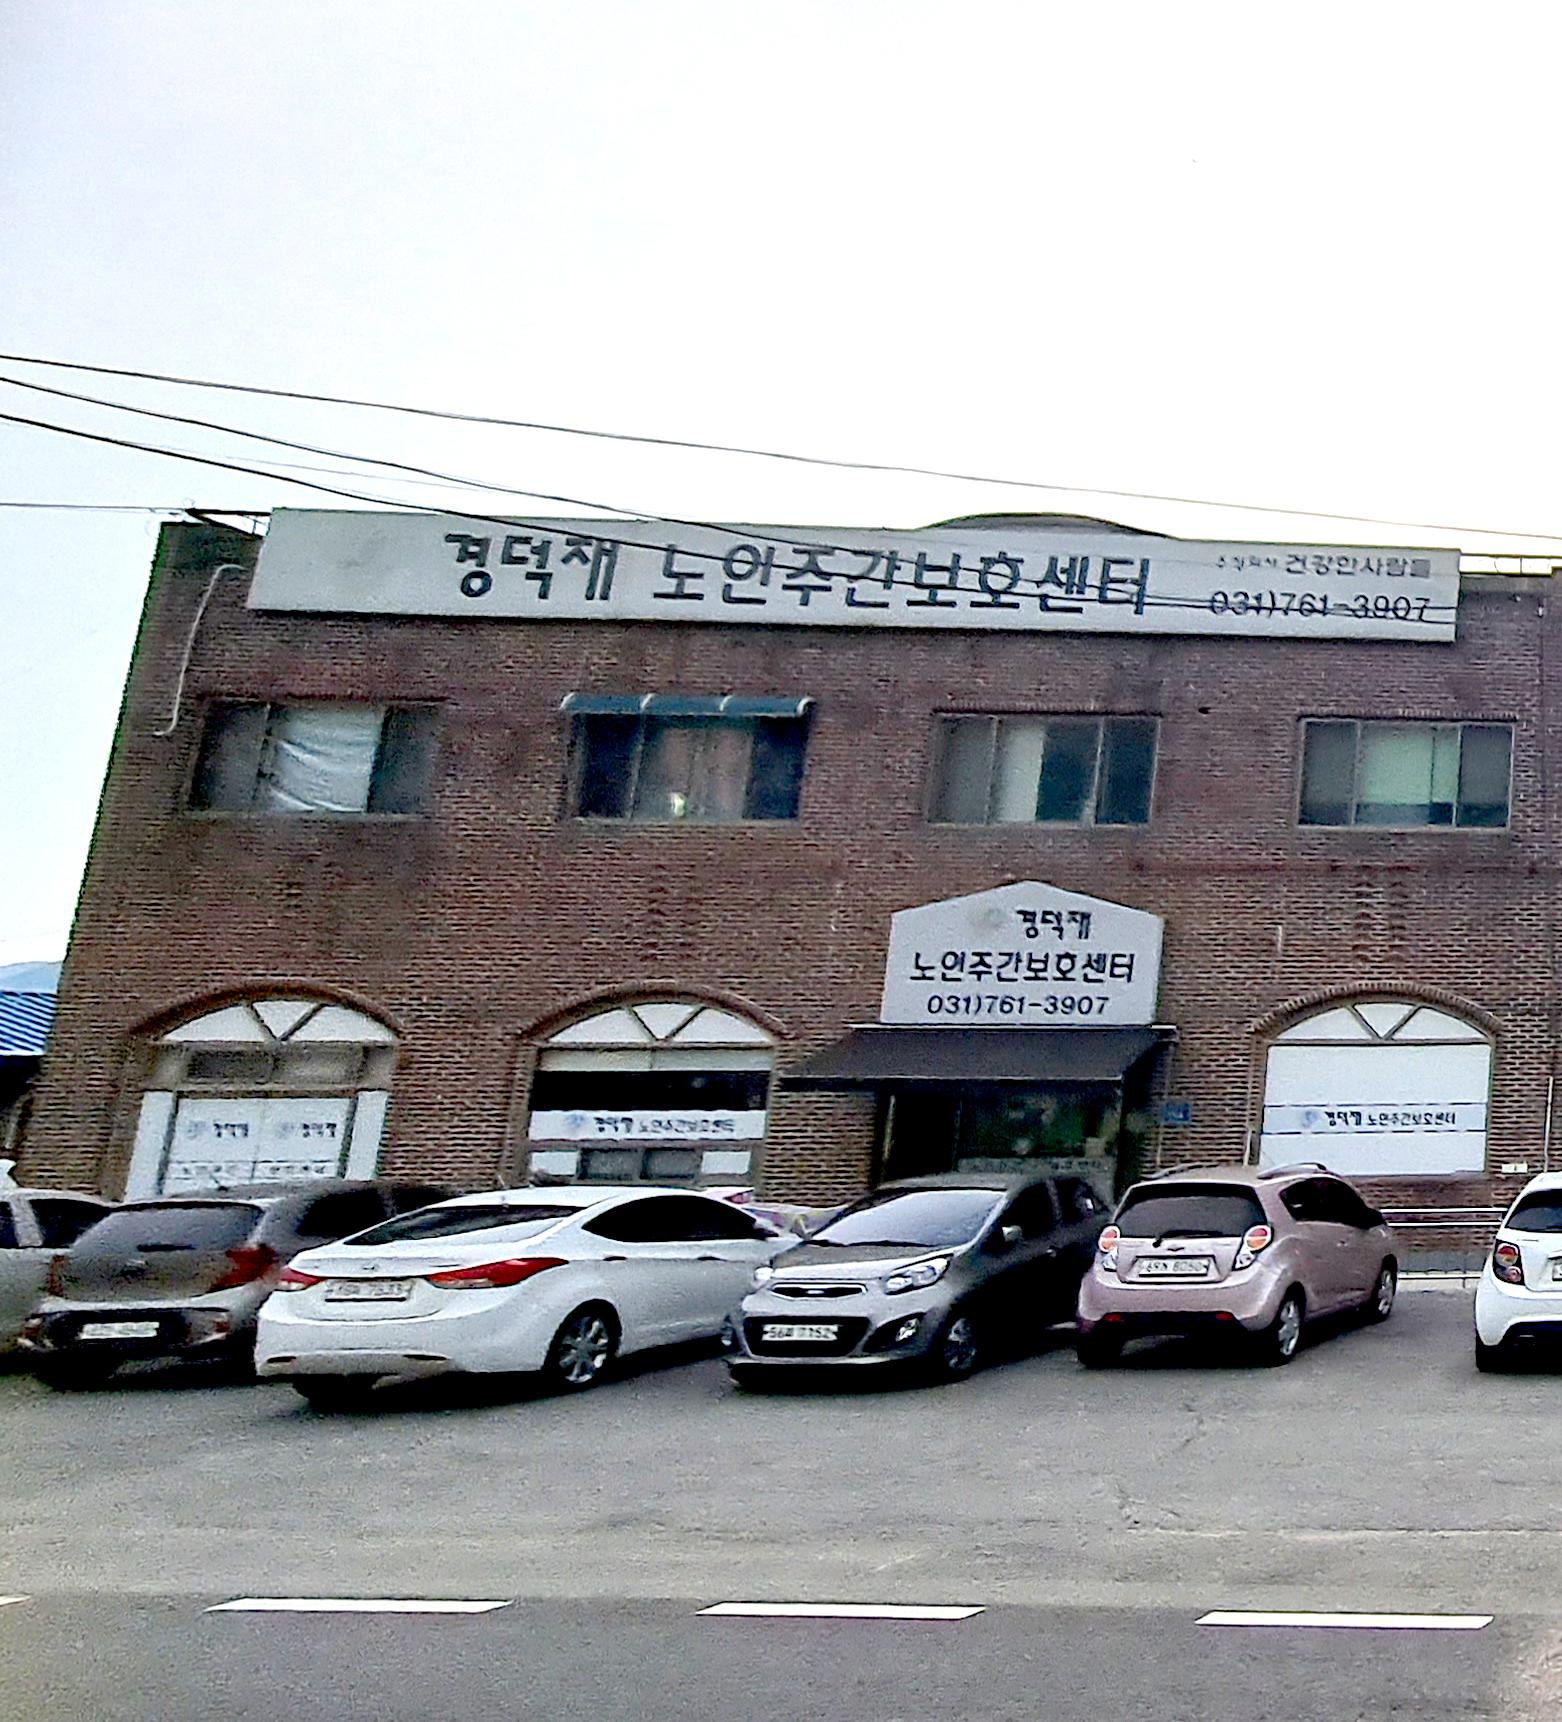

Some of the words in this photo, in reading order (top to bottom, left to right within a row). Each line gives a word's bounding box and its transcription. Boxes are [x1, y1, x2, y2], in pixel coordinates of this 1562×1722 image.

[444, 532, 620, 602] 경덕재
[653, 543, 1151, 616] 노인주간보호센터
[1211, 590, 1430, 623] 031)761-3907
[1016, 909, 1093, 940] 경덕재
[910, 950, 1135, 983] 노인주간보호센터
[927, 994, 1109, 1016] 031)761-3907
